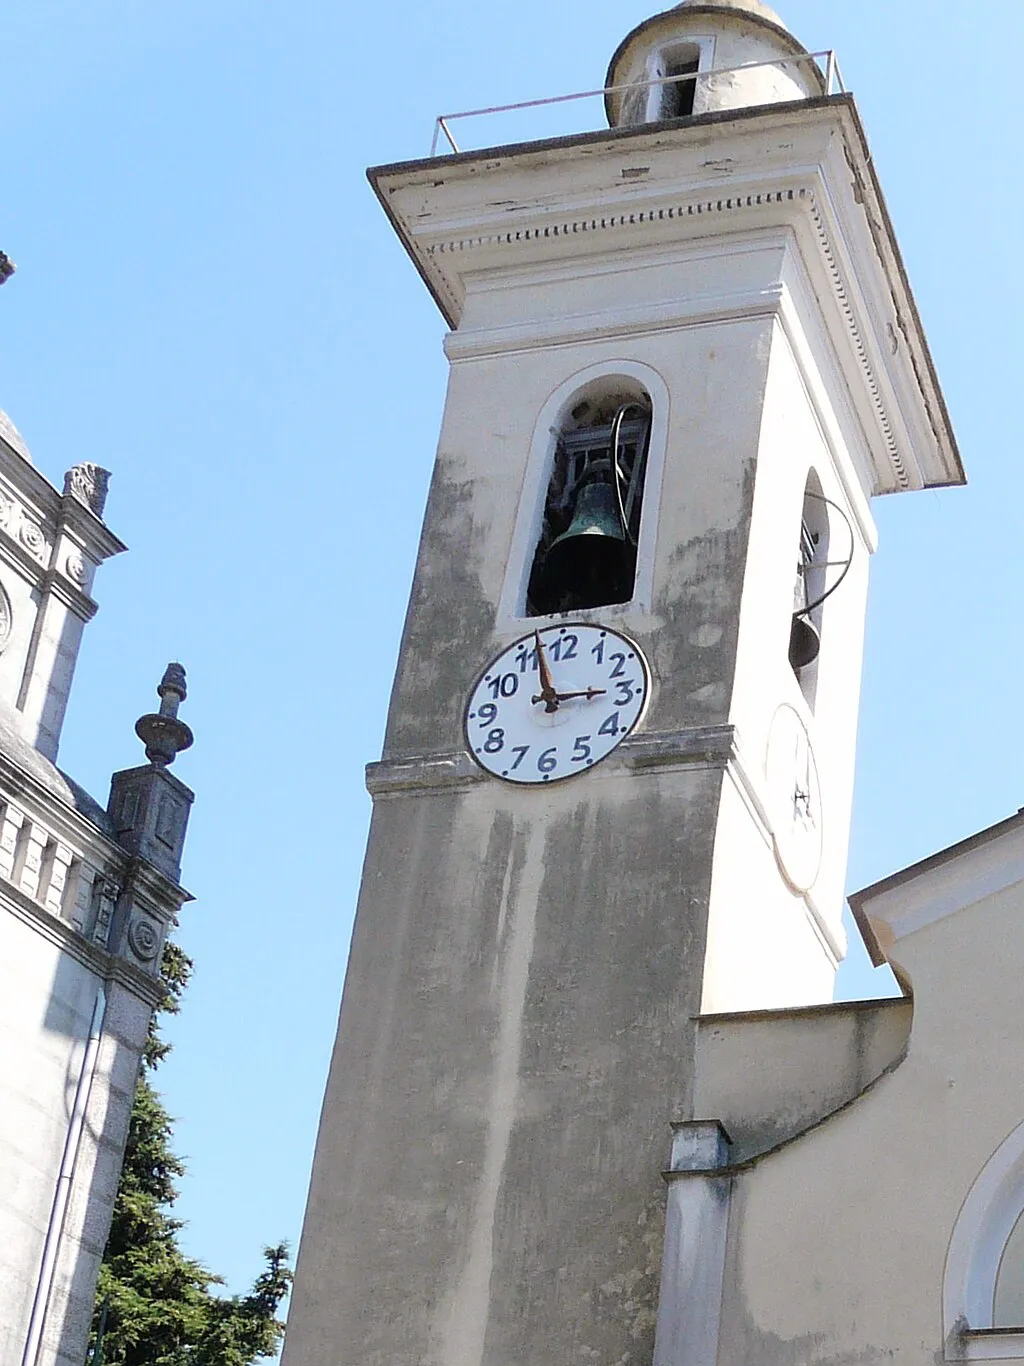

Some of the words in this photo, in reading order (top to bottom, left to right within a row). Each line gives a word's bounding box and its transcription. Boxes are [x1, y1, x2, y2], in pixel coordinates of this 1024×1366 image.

[515, 648, 539, 672] 11
[549, 635, 578, 661] 12
[591, 640, 603, 664] 1
[609, 653, 625, 678] 2
[488, 673, 518, 699] 10
[614, 679, 634, 705] 3
[478, 704, 497, 728] 9
[598, 712, 619, 736] 4
[484, 729, 504, 753] 8
[571, 736, 591, 762] 5
[511, 746, 530, 770] 7
[537, 748, 557, 772] 6
